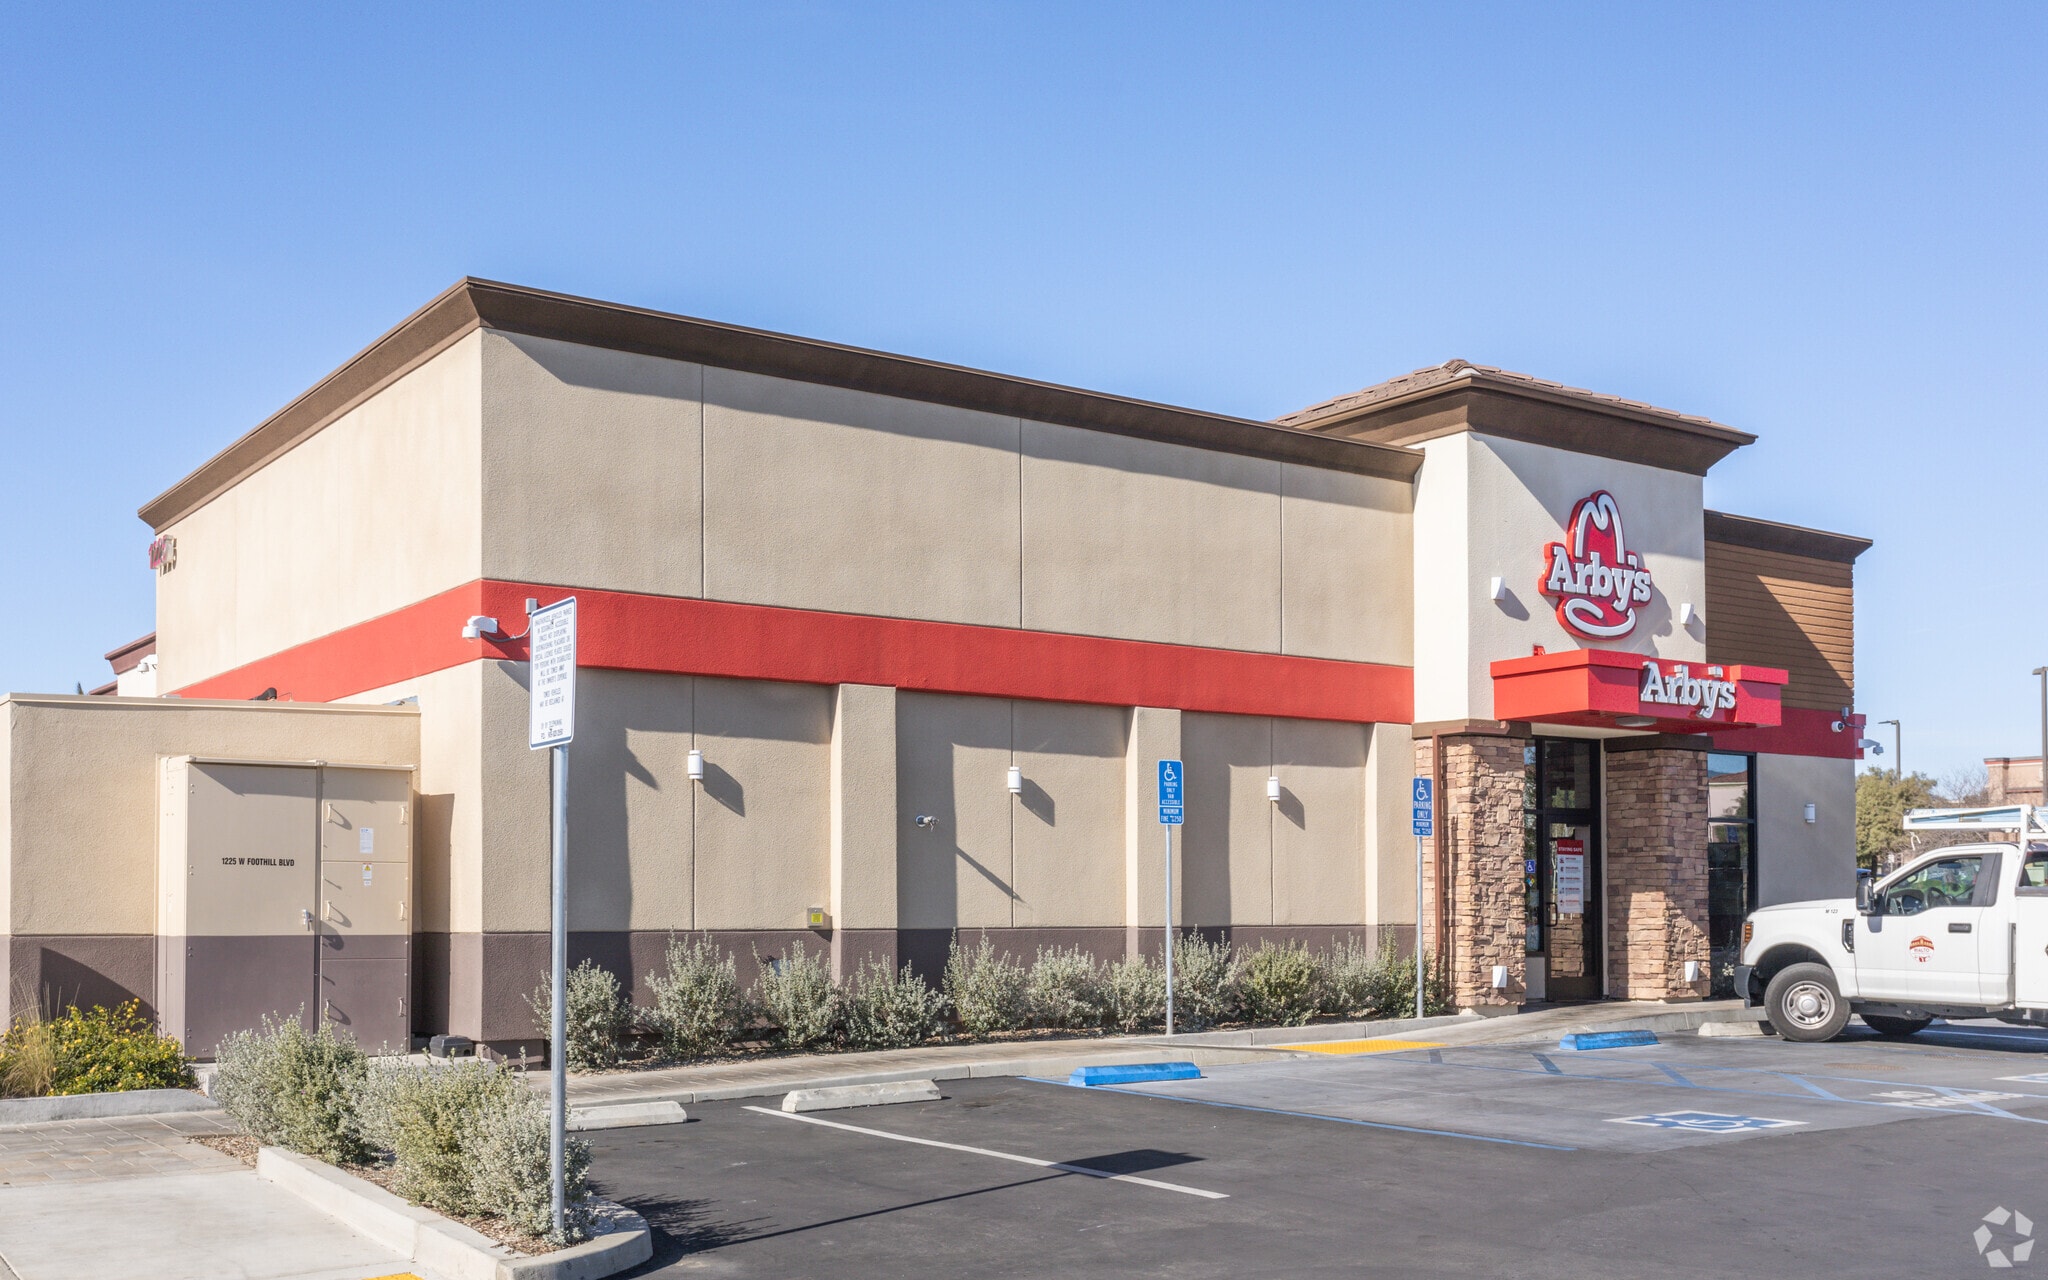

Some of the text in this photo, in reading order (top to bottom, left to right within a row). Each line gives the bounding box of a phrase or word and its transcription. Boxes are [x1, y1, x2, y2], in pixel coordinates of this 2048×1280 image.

[1547, 545, 1652, 613] Arby's
[1640, 660, 1736, 719] Arby's
[1414, 801, 1431, 809] PARKING
[221, 857, 295, 867] 1225 W FOOTHILL BLVD
